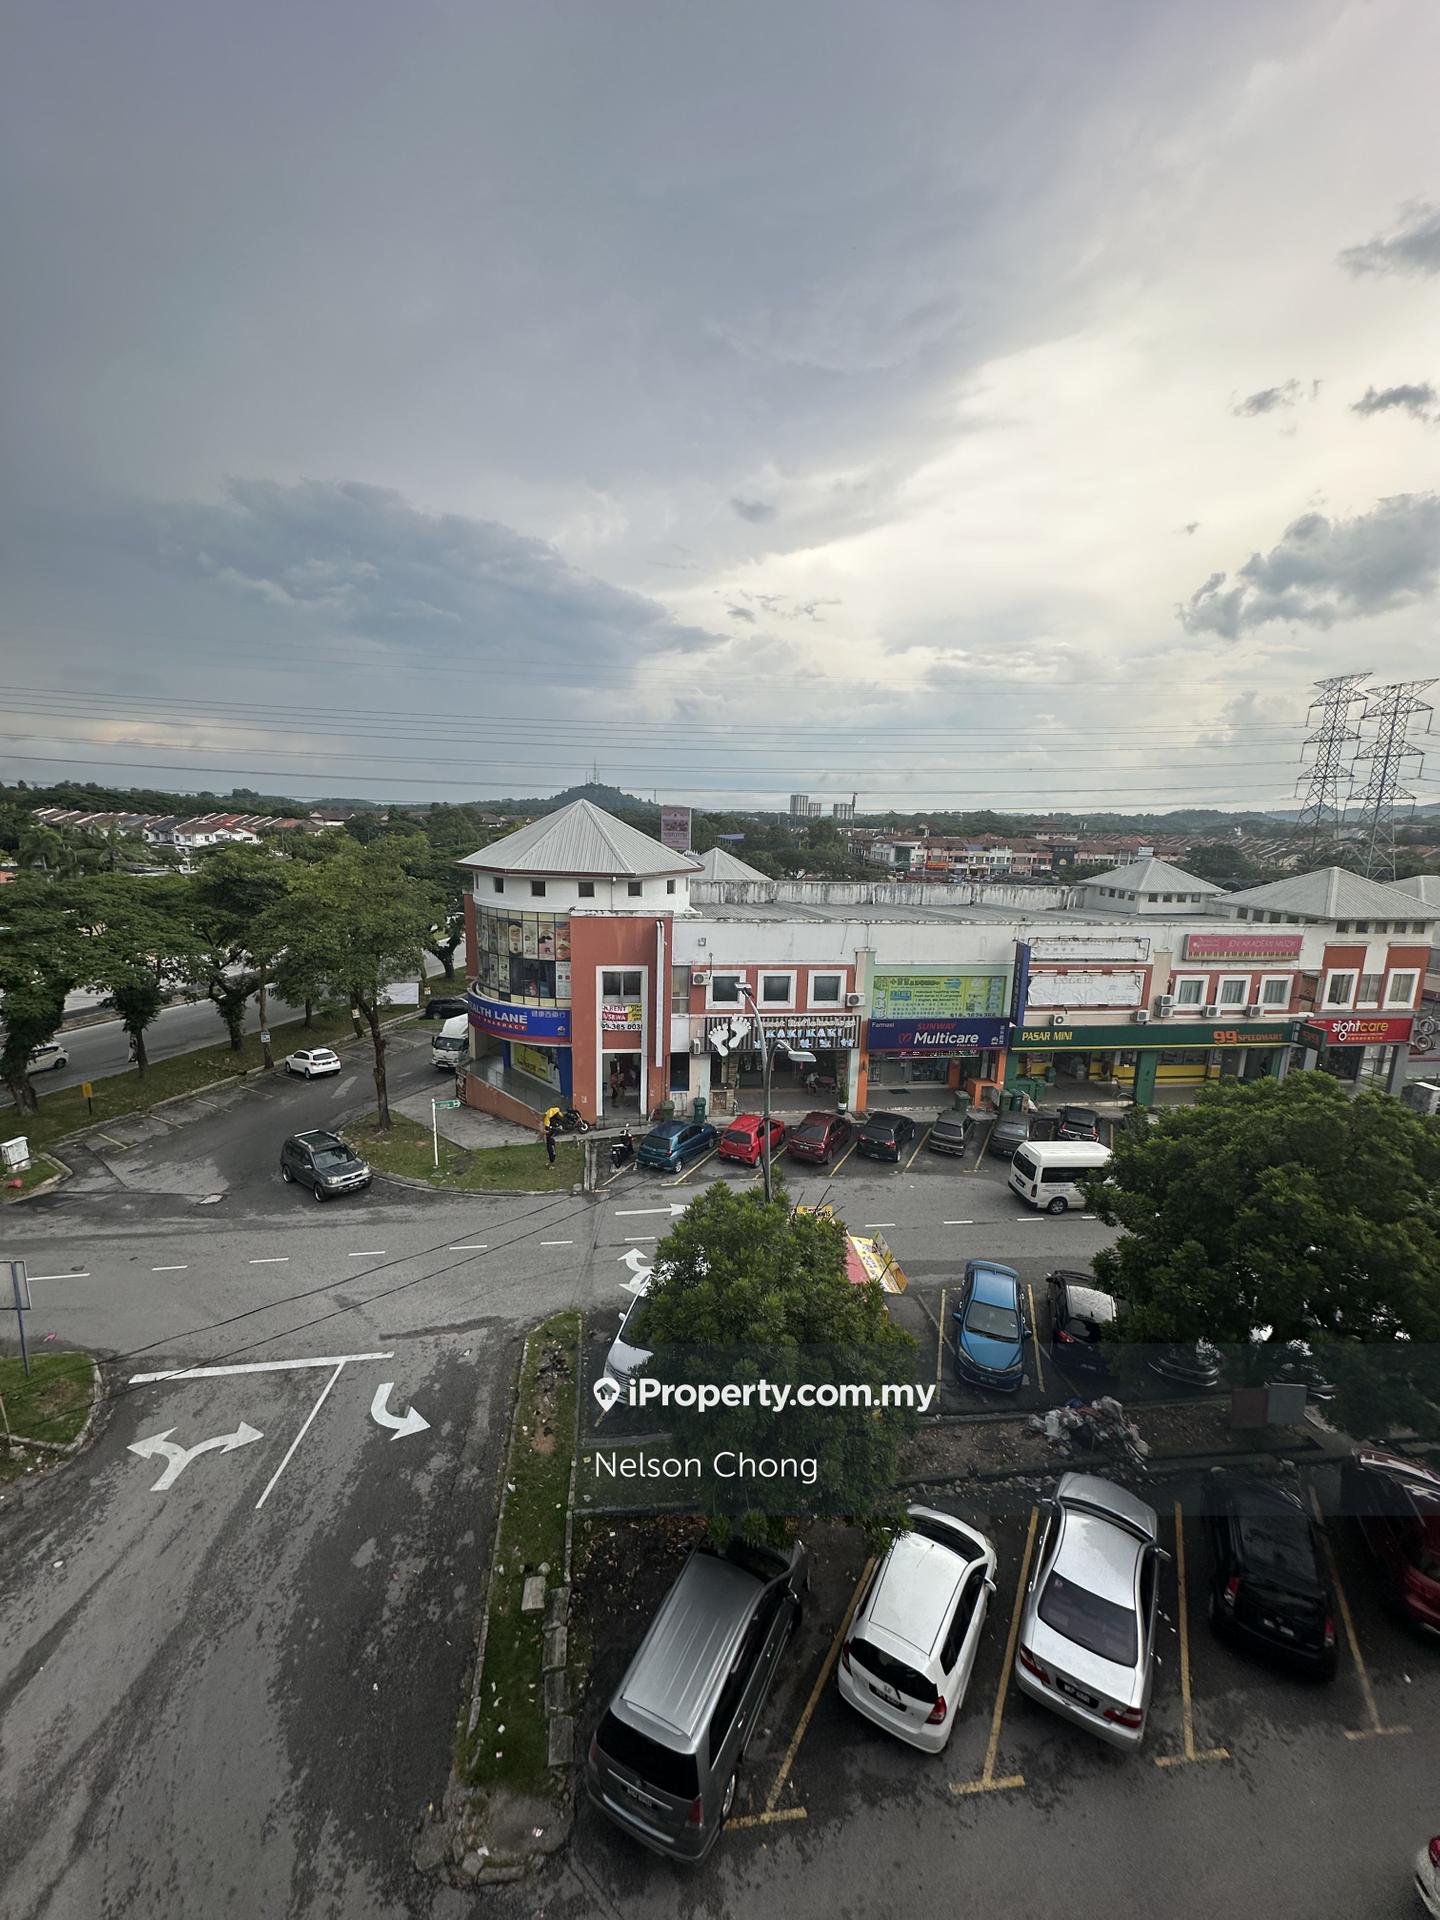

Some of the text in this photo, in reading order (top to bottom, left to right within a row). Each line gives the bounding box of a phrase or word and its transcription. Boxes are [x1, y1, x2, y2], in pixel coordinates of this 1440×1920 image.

[494, 1010, 528, 1024] LANE
[766, 1028, 843, 1038] KAKI KAKI
[917, 1022, 957, 1030] SUNWAY
[1331, 1020, 1389, 1042] sightcare
[913, 1031, 979, 1045] Multicare
[1022, 1031, 1073, 1041] PASAR MINI
[1213, 1030, 1284, 1044] 99 SPEEDMART
